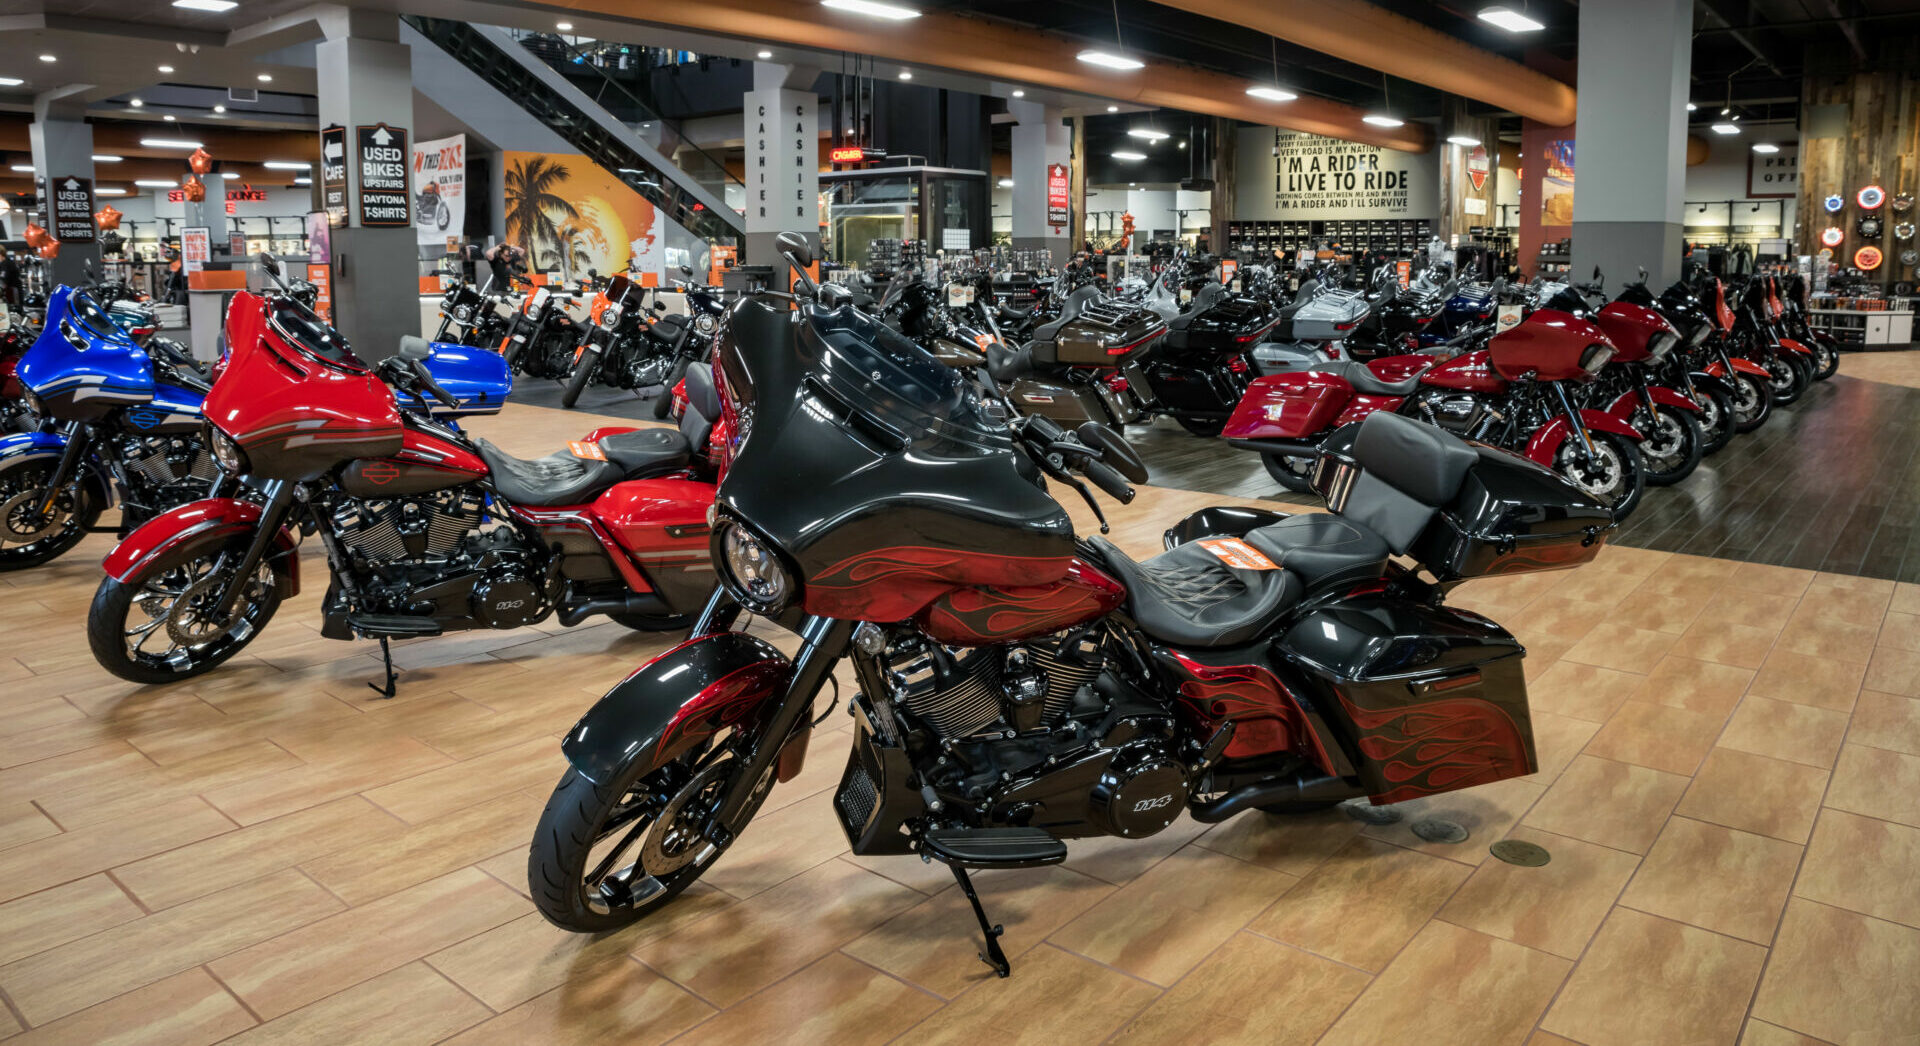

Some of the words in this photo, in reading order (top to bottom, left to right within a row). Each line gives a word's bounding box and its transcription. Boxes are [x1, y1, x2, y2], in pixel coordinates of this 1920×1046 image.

[364, 147, 402, 162] USED
[1302, 147, 1323, 155] ROAD
[1335, 146, 1348, 154] MY
[1350, 145, 1382, 153] NATION
[1276, 156, 1303, 173] I'M
[1310, 156, 1321, 172] A
[1328, 154, 1379, 172] RIDER
[325, 165, 344, 180] CAFE
[363, 162, 405, 178] BIKES
[363, 179, 405, 189] UPSTAIRS
[1051, 177, 1066, 186] USED
[1276, 175, 1281, 192] I
[1289, 173, 1326, 191] LIVE
[1334, 172, 1356, 191] TO
[1364, 170, 1408, 190] RIDE
[57, 191, 88, 200] USED
[363, 195, 406, 205] DAYTONA
[57, 201, 90, 211] BIKES
[1276, 200, 1290, 209] I'M
[1292, 200, 1298, 208] A
[1301, 200, 1326, 208] RIDER
[1328, 199, 1348, 208] AND
[1351, 199, 1365, 207] I'LL
[1368, 198, 1408, 207] SURVIVE
[364, 207, 407, 219] T-SHIRTS
[59, 230, 93, 238] T-SHIRTS
[1134, 794, 1173, 811] 114
